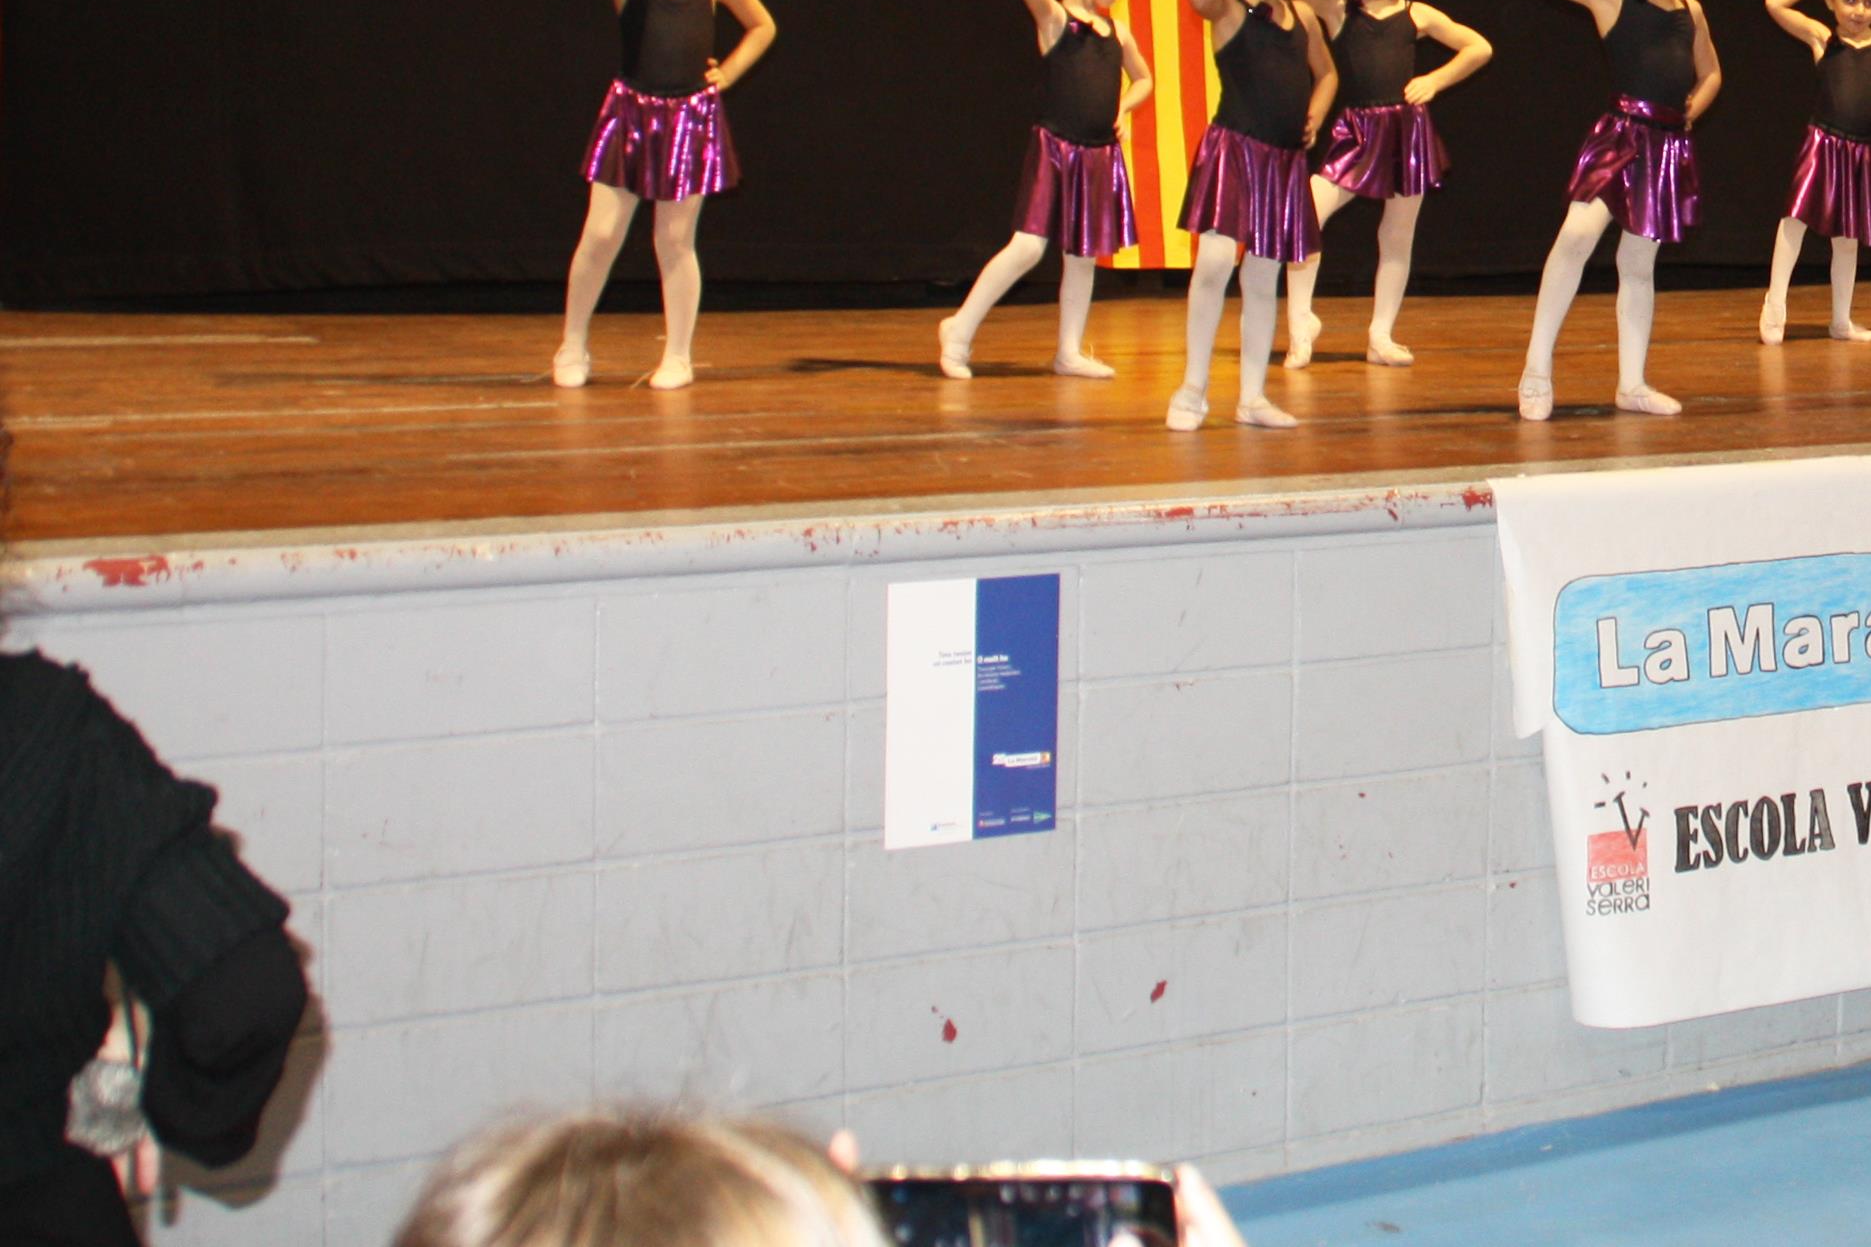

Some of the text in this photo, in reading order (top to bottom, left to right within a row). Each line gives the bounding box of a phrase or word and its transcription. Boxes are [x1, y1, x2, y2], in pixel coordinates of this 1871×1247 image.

[1596, 616, 1690, 689] La
[1674, 788, 1836, 873] ESCOLA
[1591, 862, 1645, 880] ESCOLA
